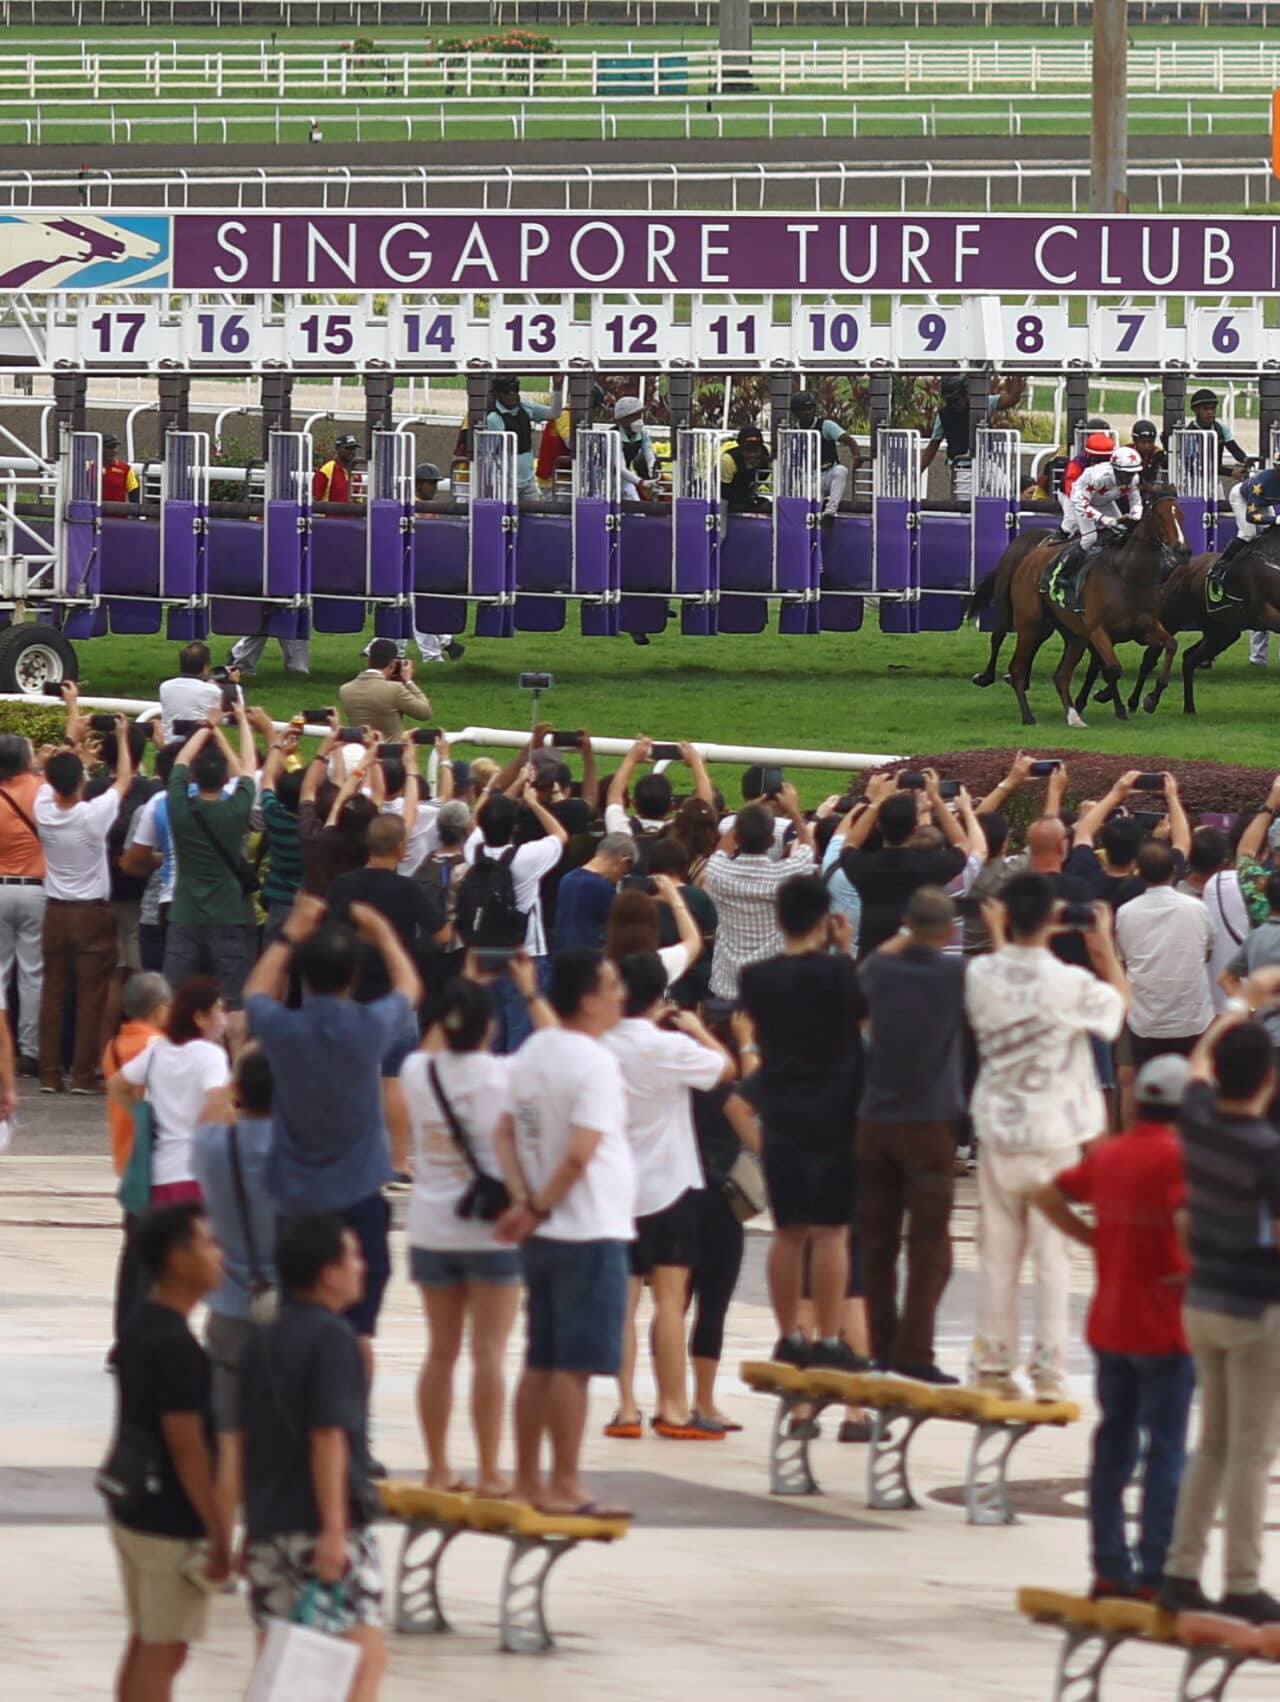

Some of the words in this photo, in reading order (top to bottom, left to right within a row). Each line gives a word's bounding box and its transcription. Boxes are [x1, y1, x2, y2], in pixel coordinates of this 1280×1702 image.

[213, 221, 730, 284] SINGAPORE
[786, 224, 981, 284] TURF
[1034, 225, 1234, 285] CLUB
[93, 313, 145, 352] 17
[198, 314, 250, 353] 16
[301, 315, 352, 354] 15
[403, 314, 455, 353] 14
[506, 314, 556, 352] 13
[606, 315, 657, 352] 12
[709, 315, 755, 354] 11
[809, 313, 859, 352] 10
[917, 313, 946, 352] 9
[1016, 315, 1044, 353] 8
[1116, 315, 1145, 352] 7
[1212, 316, 1240, 353] 6
